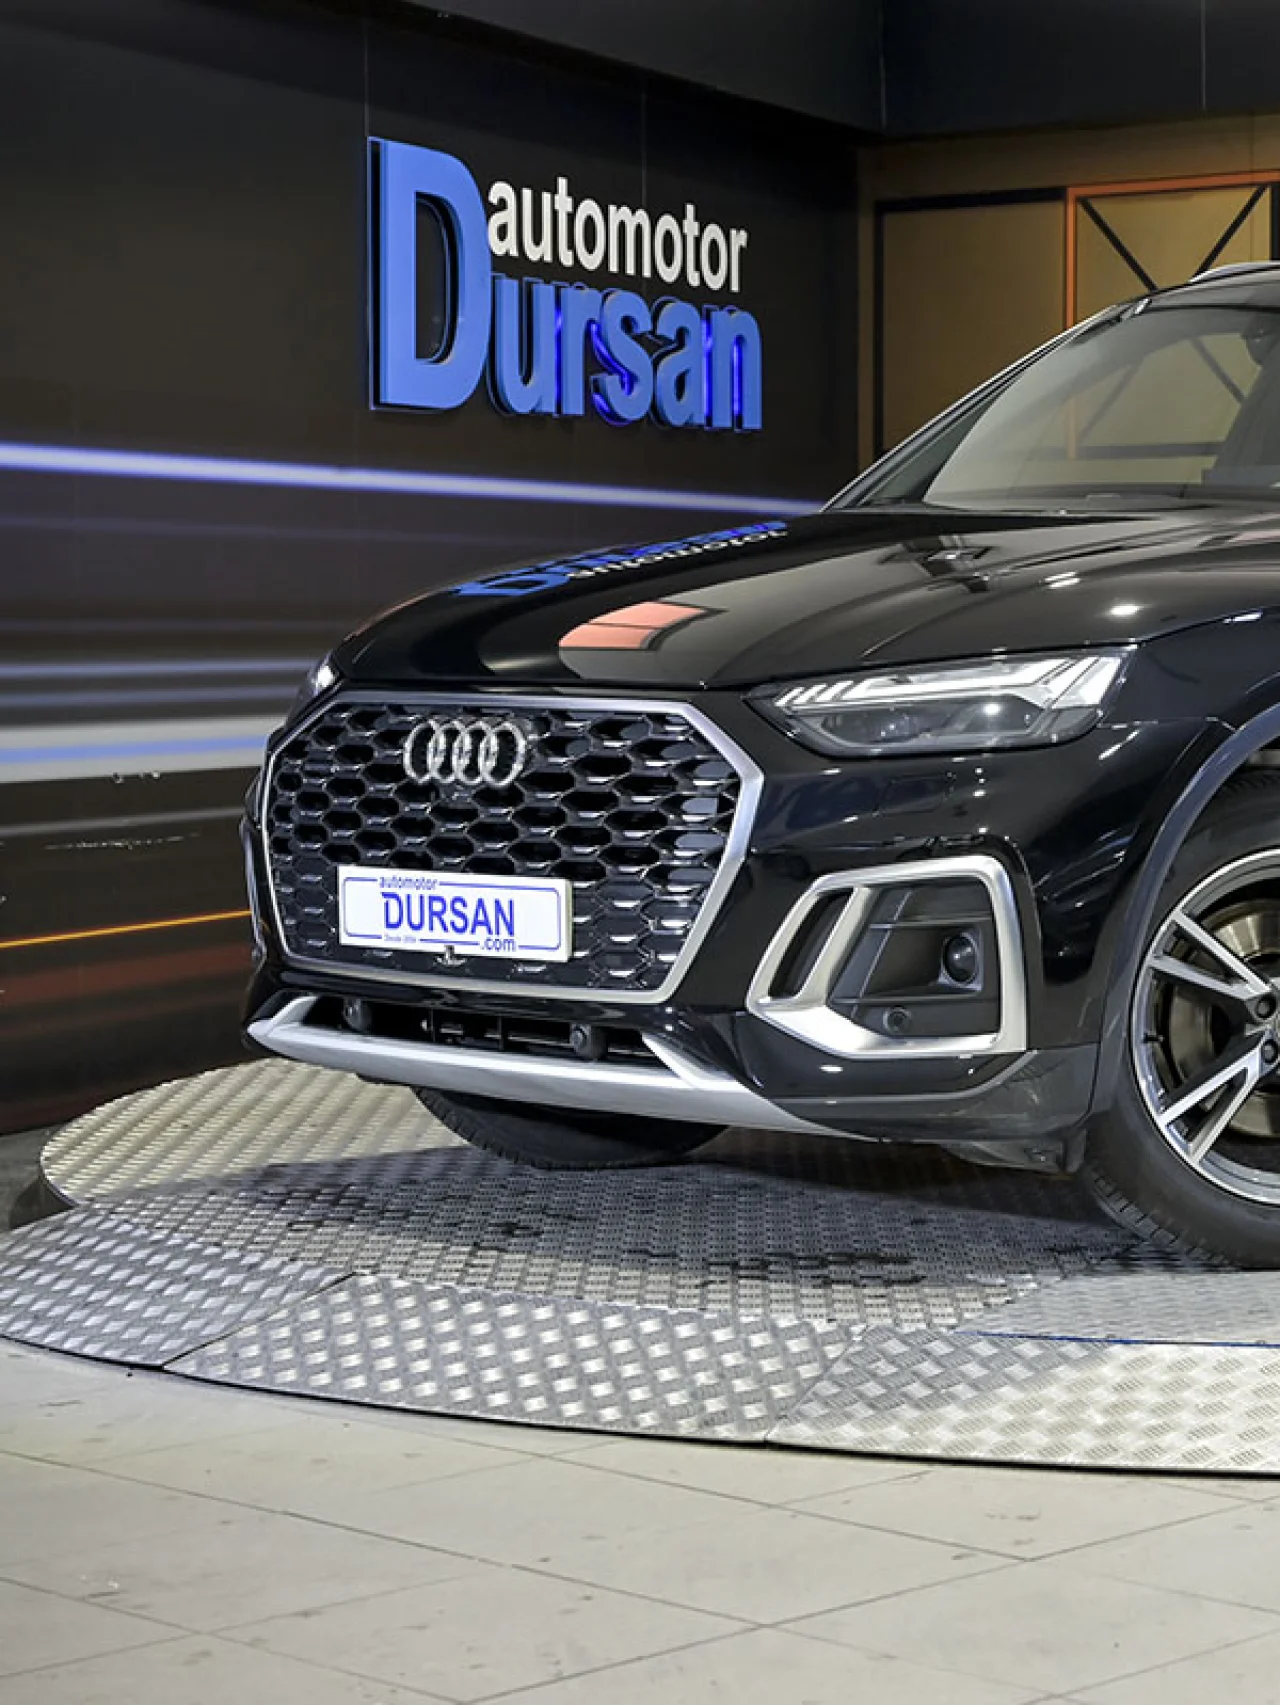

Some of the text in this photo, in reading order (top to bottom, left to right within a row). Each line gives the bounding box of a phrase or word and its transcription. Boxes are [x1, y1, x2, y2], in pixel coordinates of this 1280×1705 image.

[487, 175, 748, 293] automotor
[367, 135, 763, 433] Dursan
[381, 892, 514, 937] DURSAN
[480, 936, 517, 952] .com
